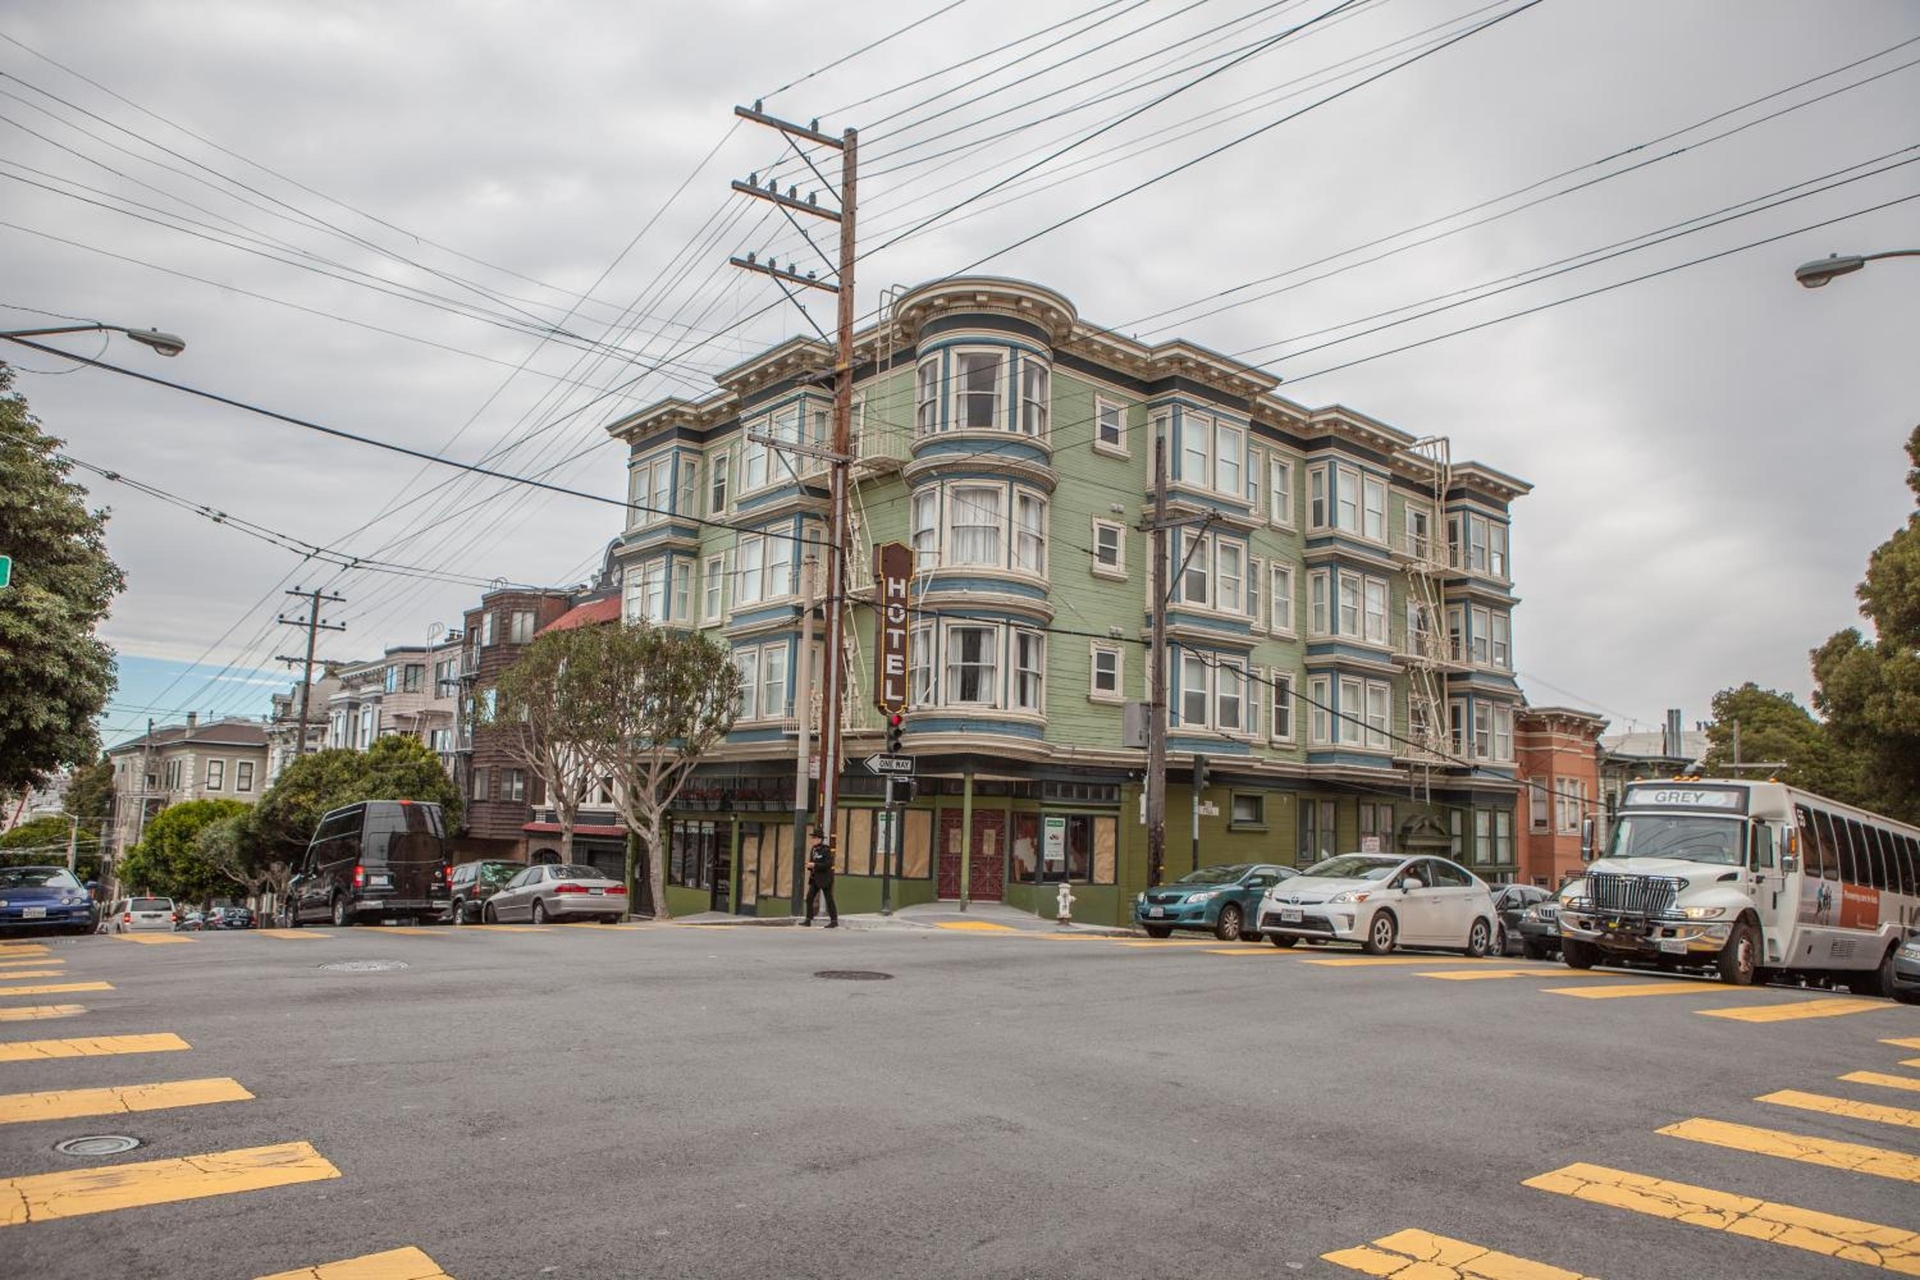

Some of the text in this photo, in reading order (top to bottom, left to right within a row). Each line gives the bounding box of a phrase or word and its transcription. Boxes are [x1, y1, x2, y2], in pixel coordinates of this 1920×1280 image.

[885, 576, 906, 701] HOTEL
[880, 760, 910, 769] ONE WAY
[1654, 791, 1705, 803] GREY
